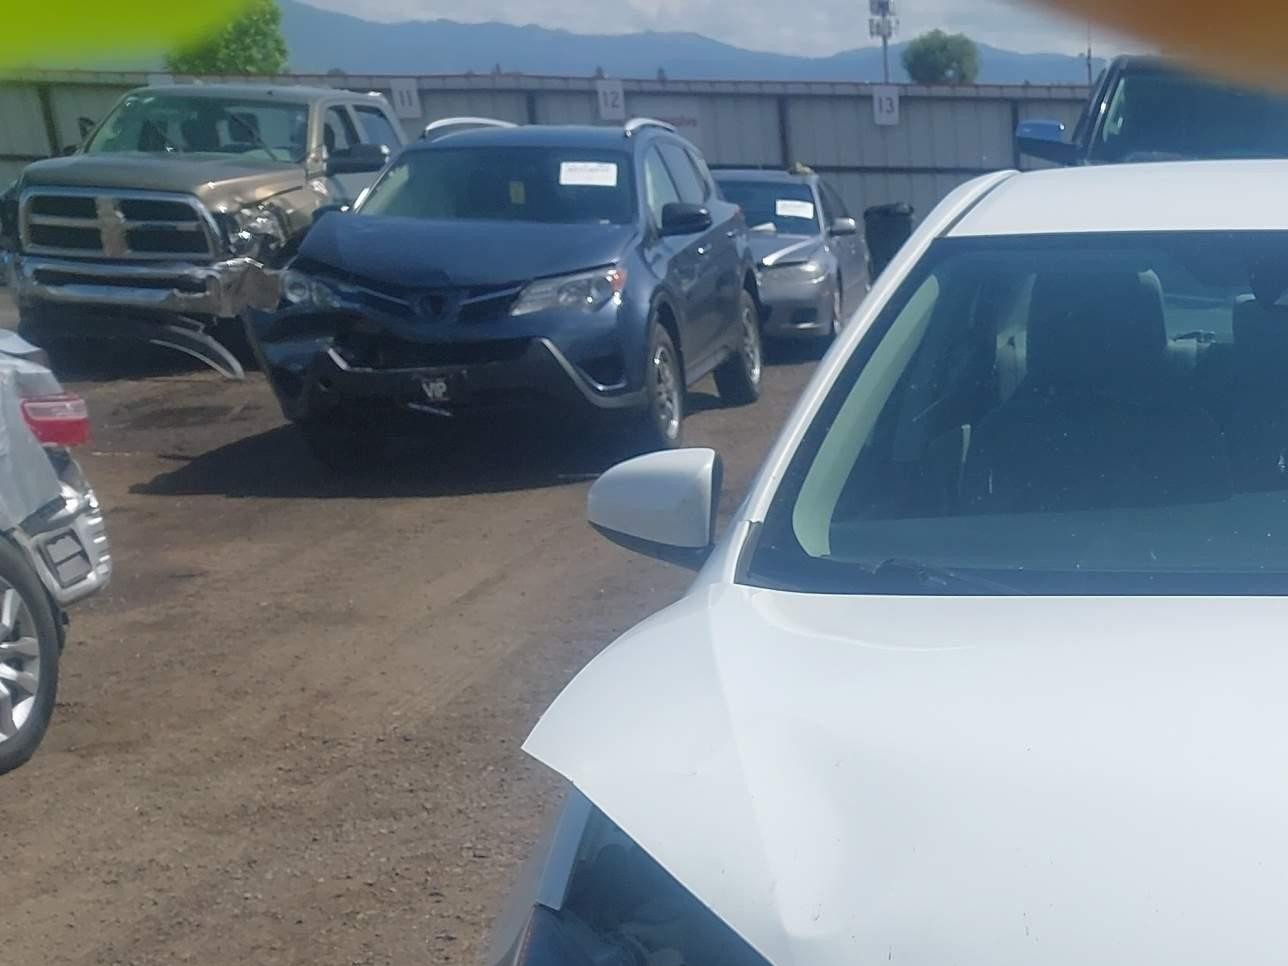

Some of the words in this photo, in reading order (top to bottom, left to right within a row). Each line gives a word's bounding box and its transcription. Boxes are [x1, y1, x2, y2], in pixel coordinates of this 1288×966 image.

[399, 89, 414, 108] 11
[601, 90, 620, 110] 12
[878, 96, 896, 114] 13
